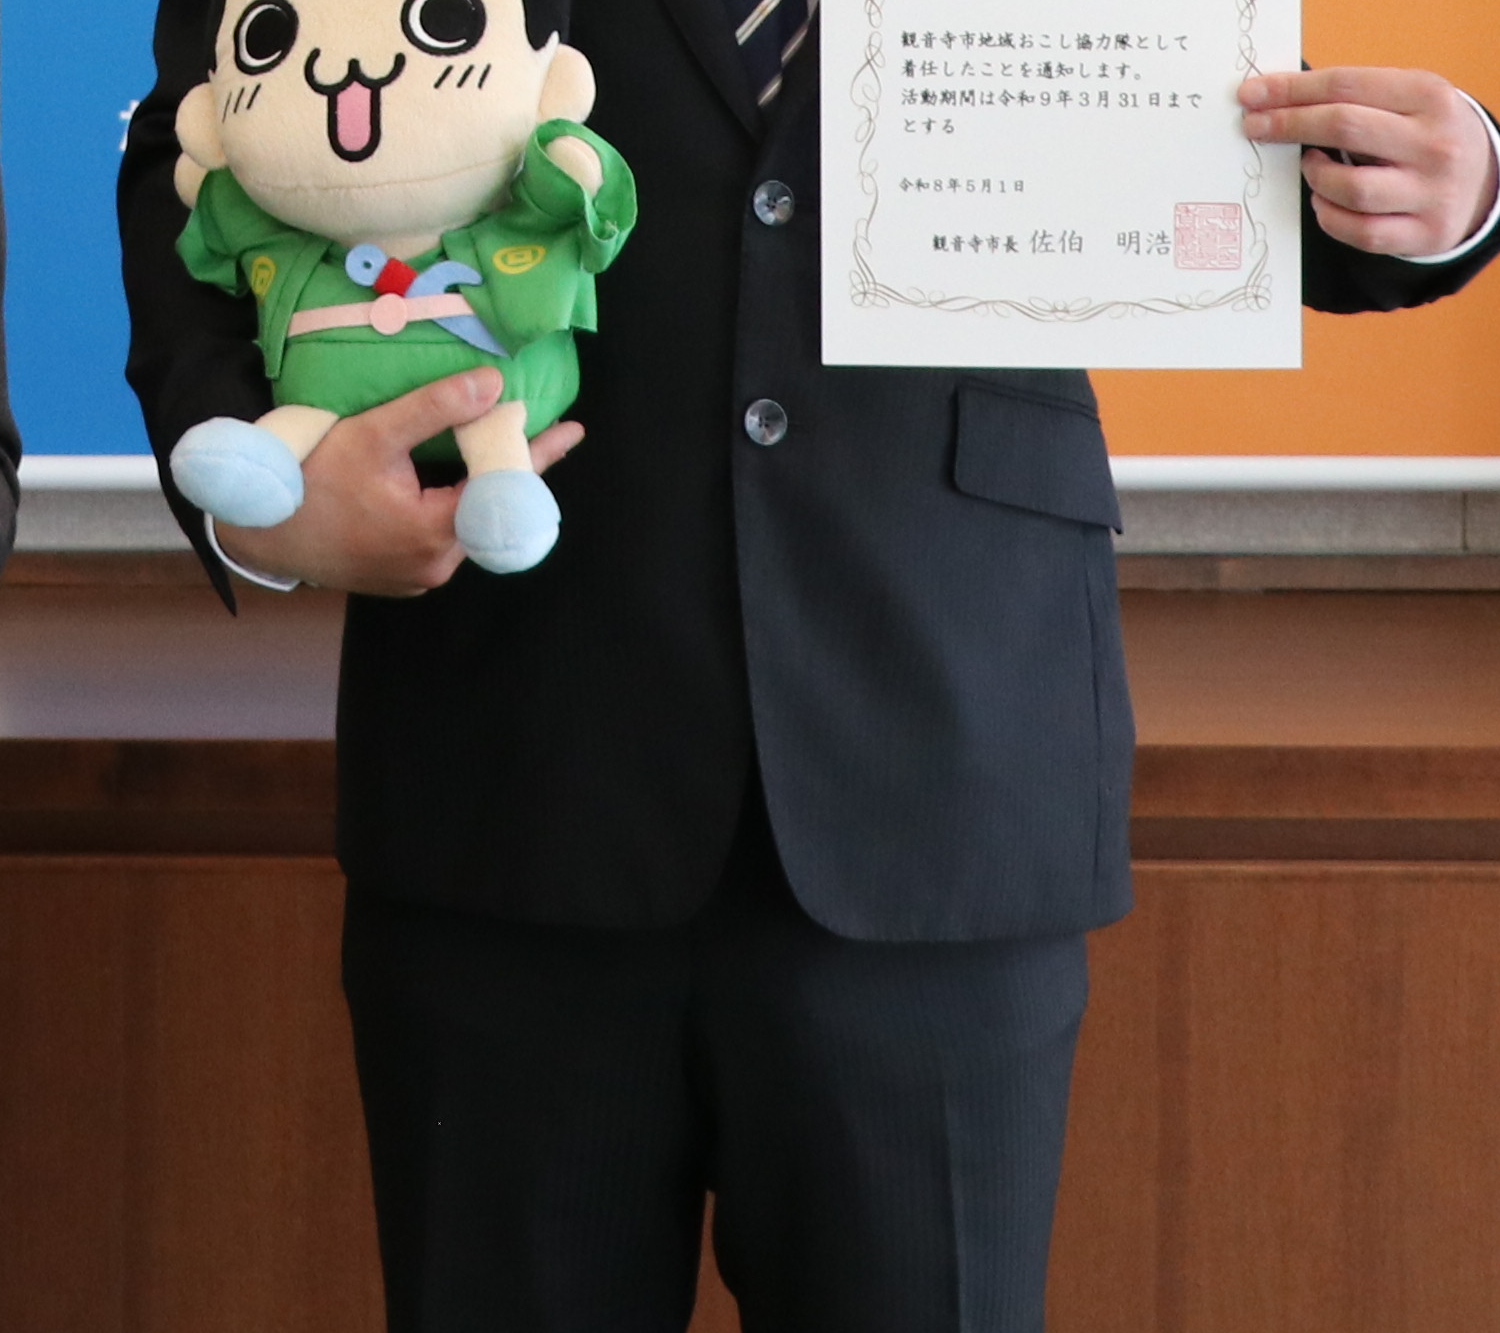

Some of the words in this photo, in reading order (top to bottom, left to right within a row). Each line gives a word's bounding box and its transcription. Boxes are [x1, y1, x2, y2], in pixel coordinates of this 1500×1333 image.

[902, 32, 1186, 50] 観音寺市地域おこし協力隊として
[904, 60, 1144, 79] 着任したことを通知します。
[906, 119, 954, 133] とする
[933, 235, 1019, 252] 観音寺市長
[1032, 231, 1082, 252] 佐伯
[1118, 232, 1169, 254] 明浩
